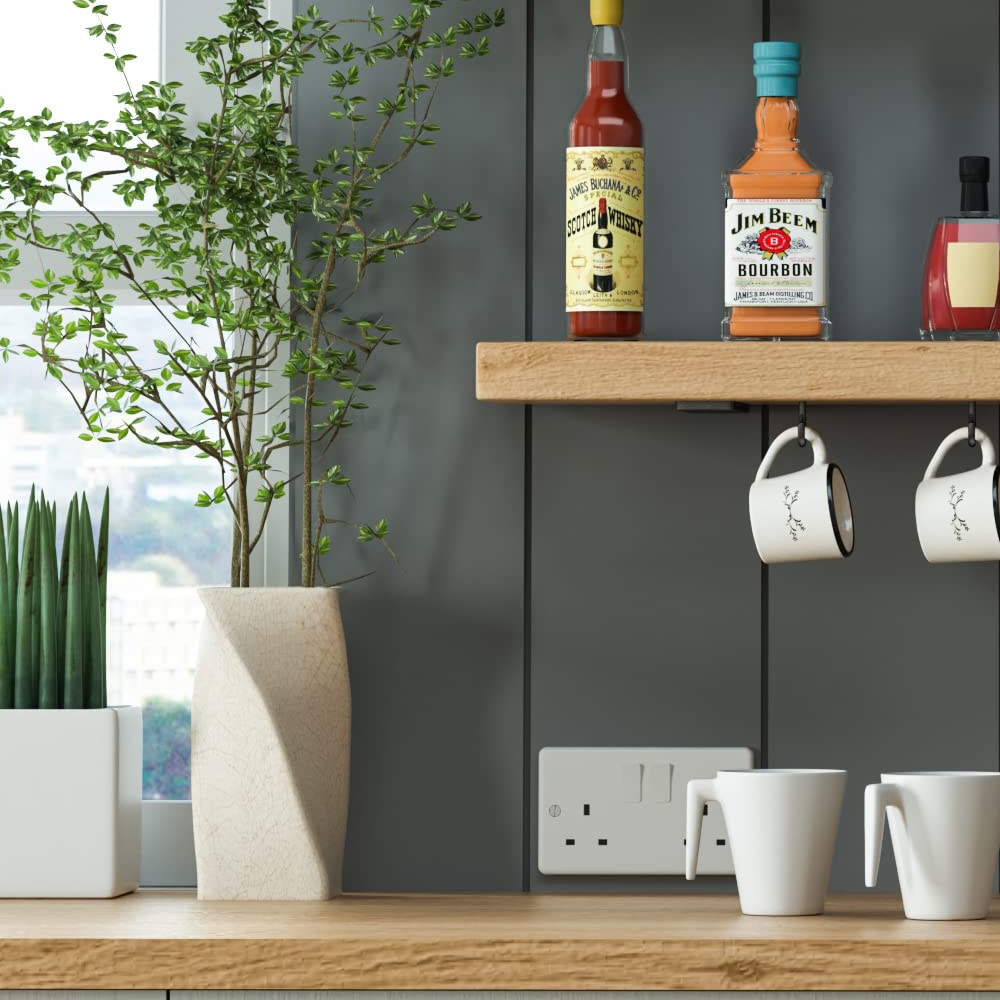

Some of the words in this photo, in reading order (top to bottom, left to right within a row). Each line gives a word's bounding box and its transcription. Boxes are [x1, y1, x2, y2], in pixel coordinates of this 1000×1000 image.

[569, 181, 589, 201] JAMES
[583, 190, 623, 201] SPECIAL
[567, 206, 597, 238] SCOTCH
[607, 206, 643, 238] WHISKY
[731, 212, 764, 235] JIM
[769, 207, 819, 234] BEEM
[738, 263, 813, 277] BOURBON
[734, 291, 753, 301] JAMES
